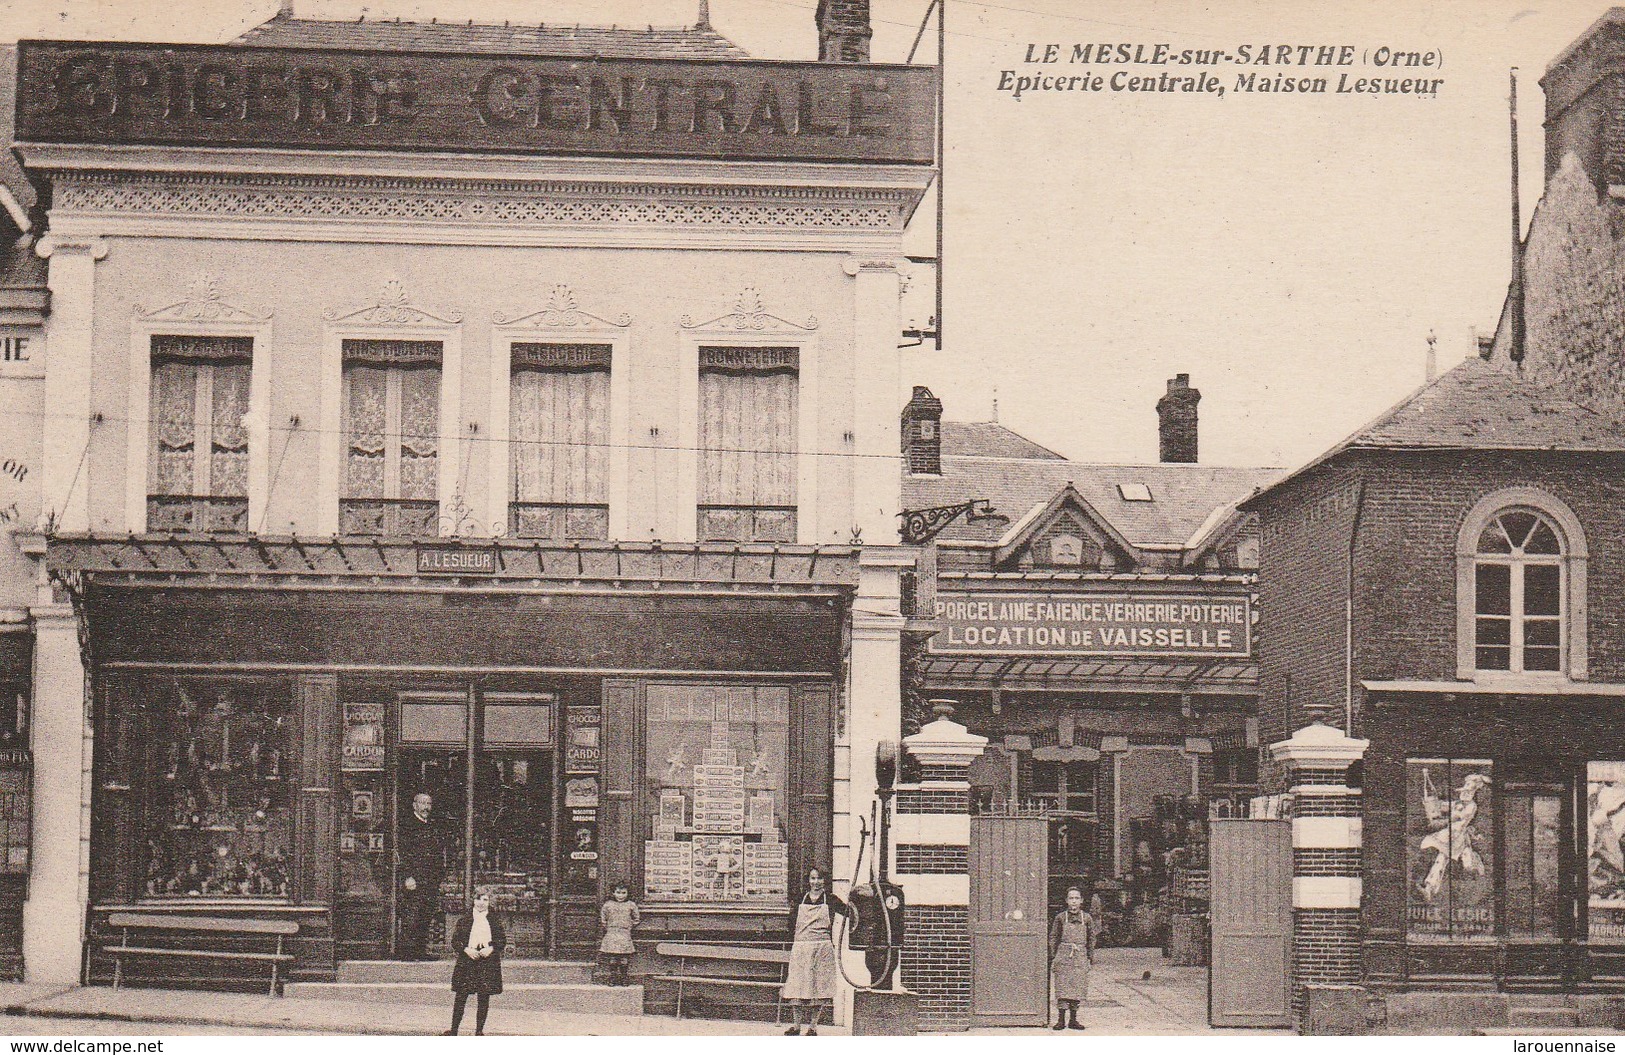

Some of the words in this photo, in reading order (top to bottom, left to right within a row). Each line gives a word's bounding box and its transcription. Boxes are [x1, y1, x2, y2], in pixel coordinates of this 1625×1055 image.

[54, 53, 418, 124] EPICERIE
[473, 65, 891, 136] CENTRALE
[0, 337, 31, 362] IE
[525, 345, 597, 361] MERCERIE
[706, 348, 791, 364] BONNETERIE
[948, 626, 1067, 646] LOCATION
[1072, 631, 1092, 646] DE
[1099, 628, 1233, 648] VAISSELLE
